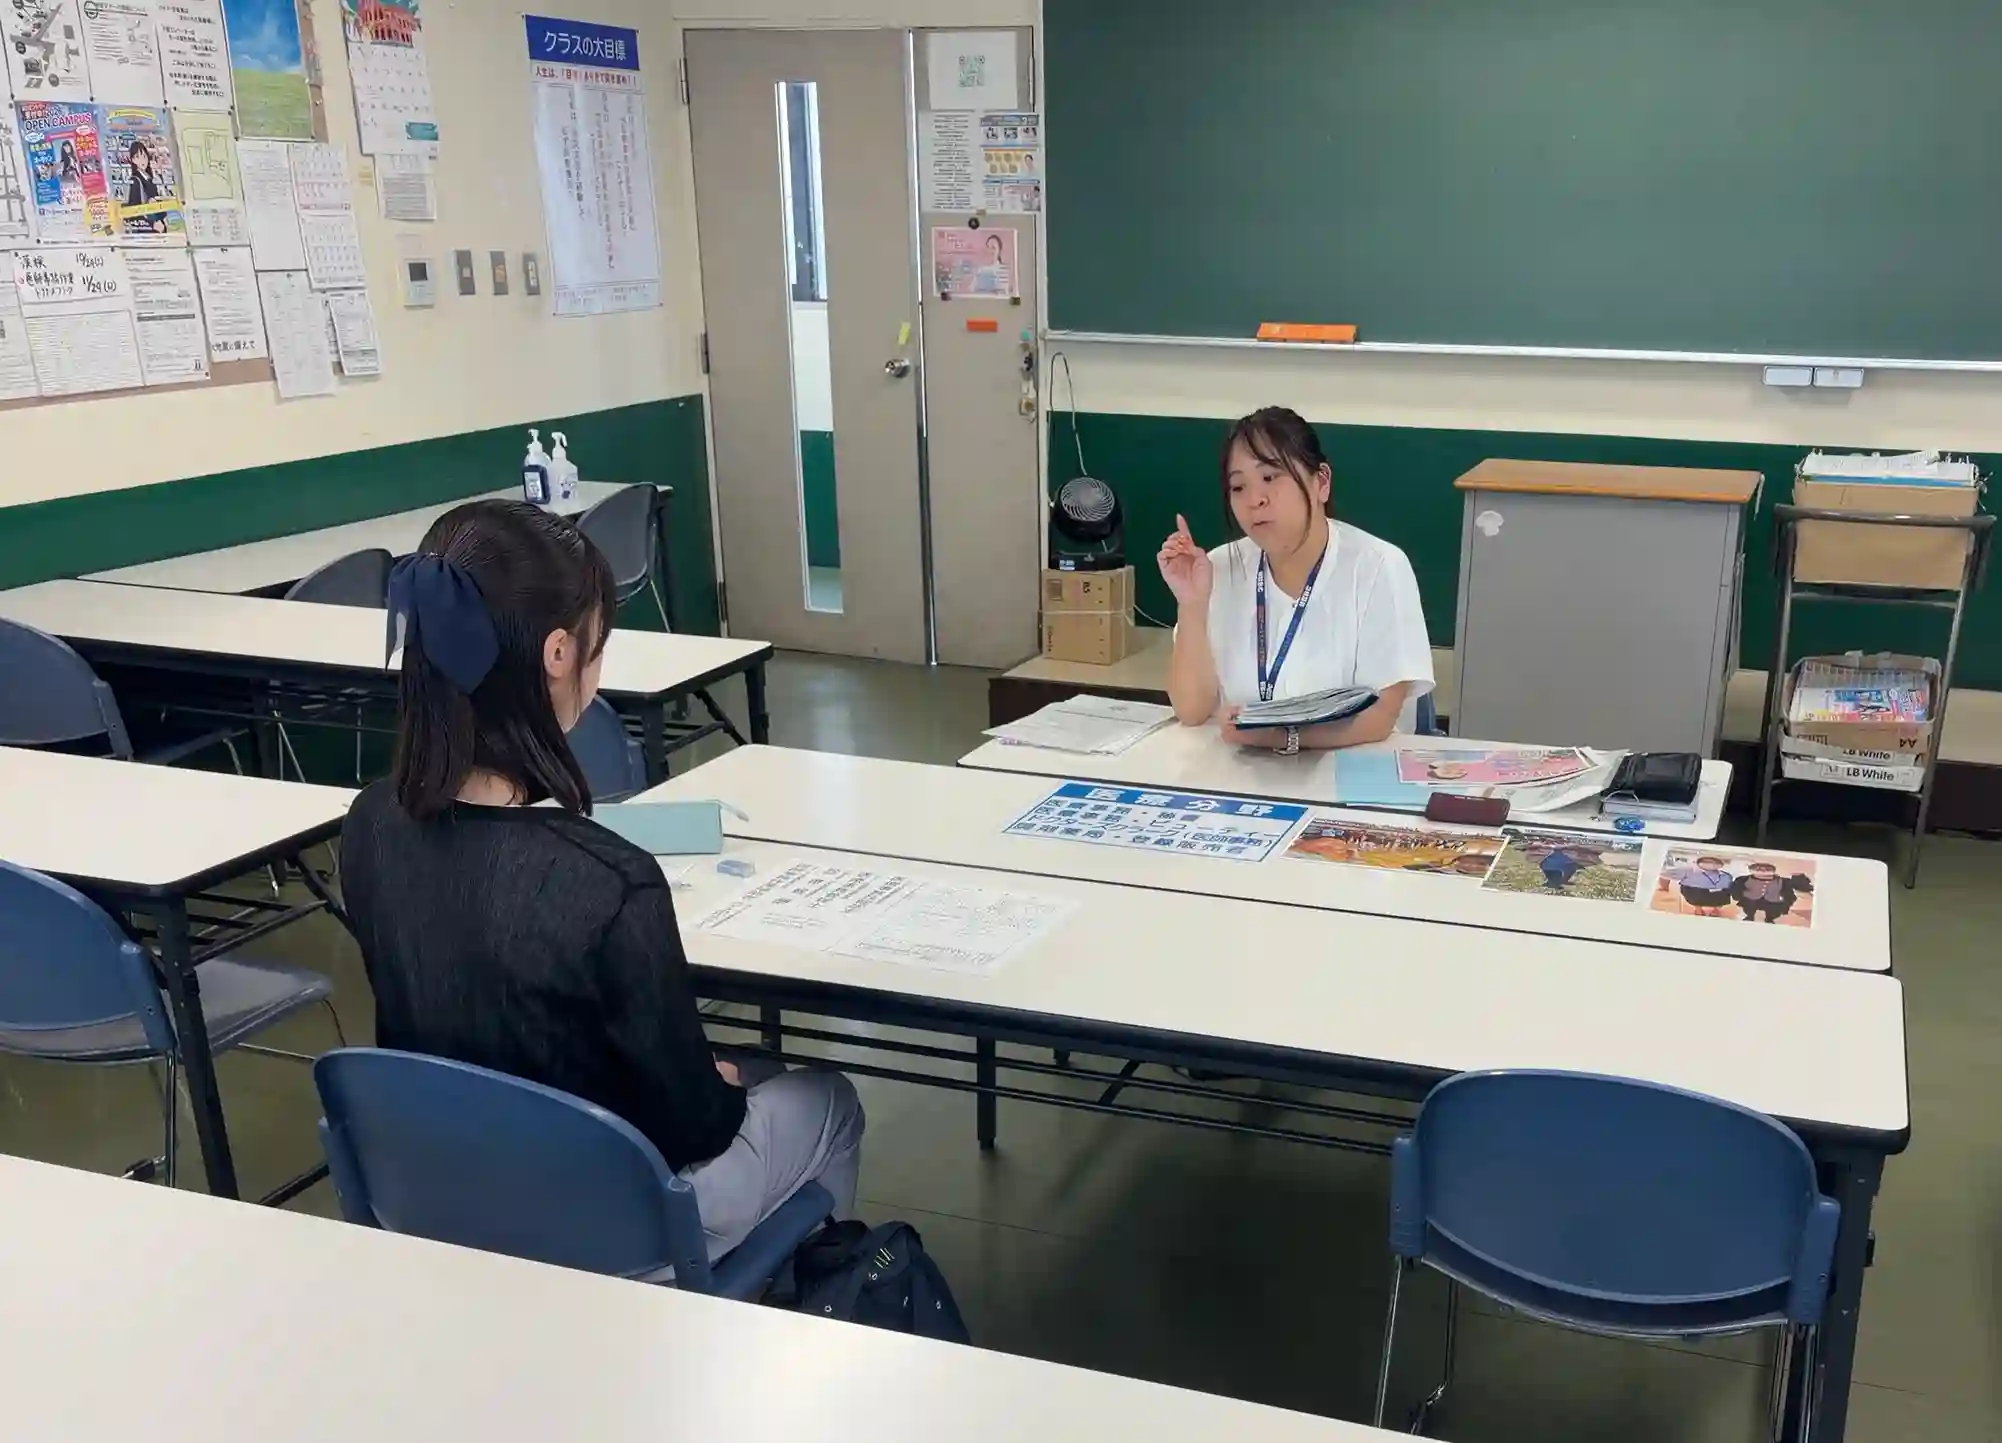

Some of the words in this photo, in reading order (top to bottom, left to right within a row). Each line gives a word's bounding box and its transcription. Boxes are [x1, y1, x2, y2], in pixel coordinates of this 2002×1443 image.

[543, 31, 627, 61] クラスの大目標
[25, 117, 51, 131] OPEN
[52, 111, 92, 127] CAMPUS
[1846, 767, 1861, 777] LB
[1862, 768, 1895, 781] White
[1084, 788, 1274, 818] 医療分野
